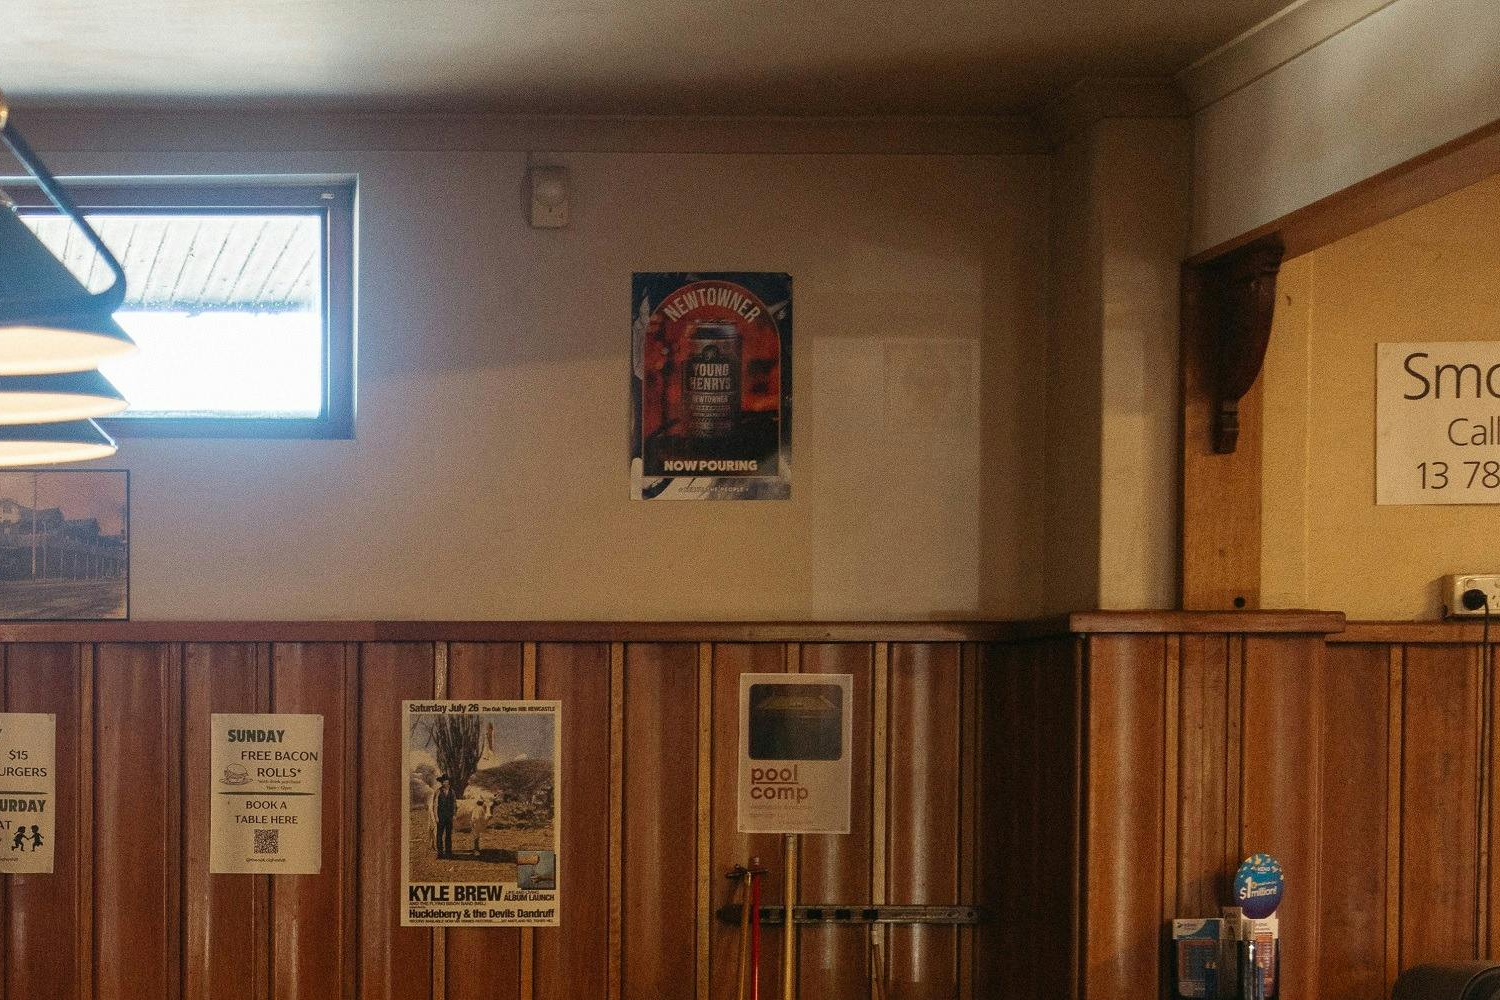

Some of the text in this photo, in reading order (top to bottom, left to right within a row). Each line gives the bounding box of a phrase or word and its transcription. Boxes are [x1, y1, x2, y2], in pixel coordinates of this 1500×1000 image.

[663, 287, 761, 322] NEWTOWNER
[693, 363, 729, 376] YOUNG
[690, 377, 731, 390] HENRYS
[1447, 416, 1500, 446] Call
[664, 460, 758, 471] NOW POURING
[1417, 461, 1500, 490] 13 78
[409, 703, 447, 714] Saturday
[448, 703, 468, 714] July
[468, 703, 479, 712] 26
[227, 729, 285, 743] SUNDAY
[8, 749, 28, 761] $15
[241, 751, 319, 761] FREE BACON
[751, 764, 798, 784] pool
[750, 786, 809, 804] comp
[245, 800, 287, 810] BOOK A
[235, 815, 298, 824] TABLE HERE
[409, 885, 503, 902] KYLE BREW
[504, 894, 555, 902] ALBUM LAUNCH
[409, 909, 555, 919] Huckleberry & the Devils Dandruff
